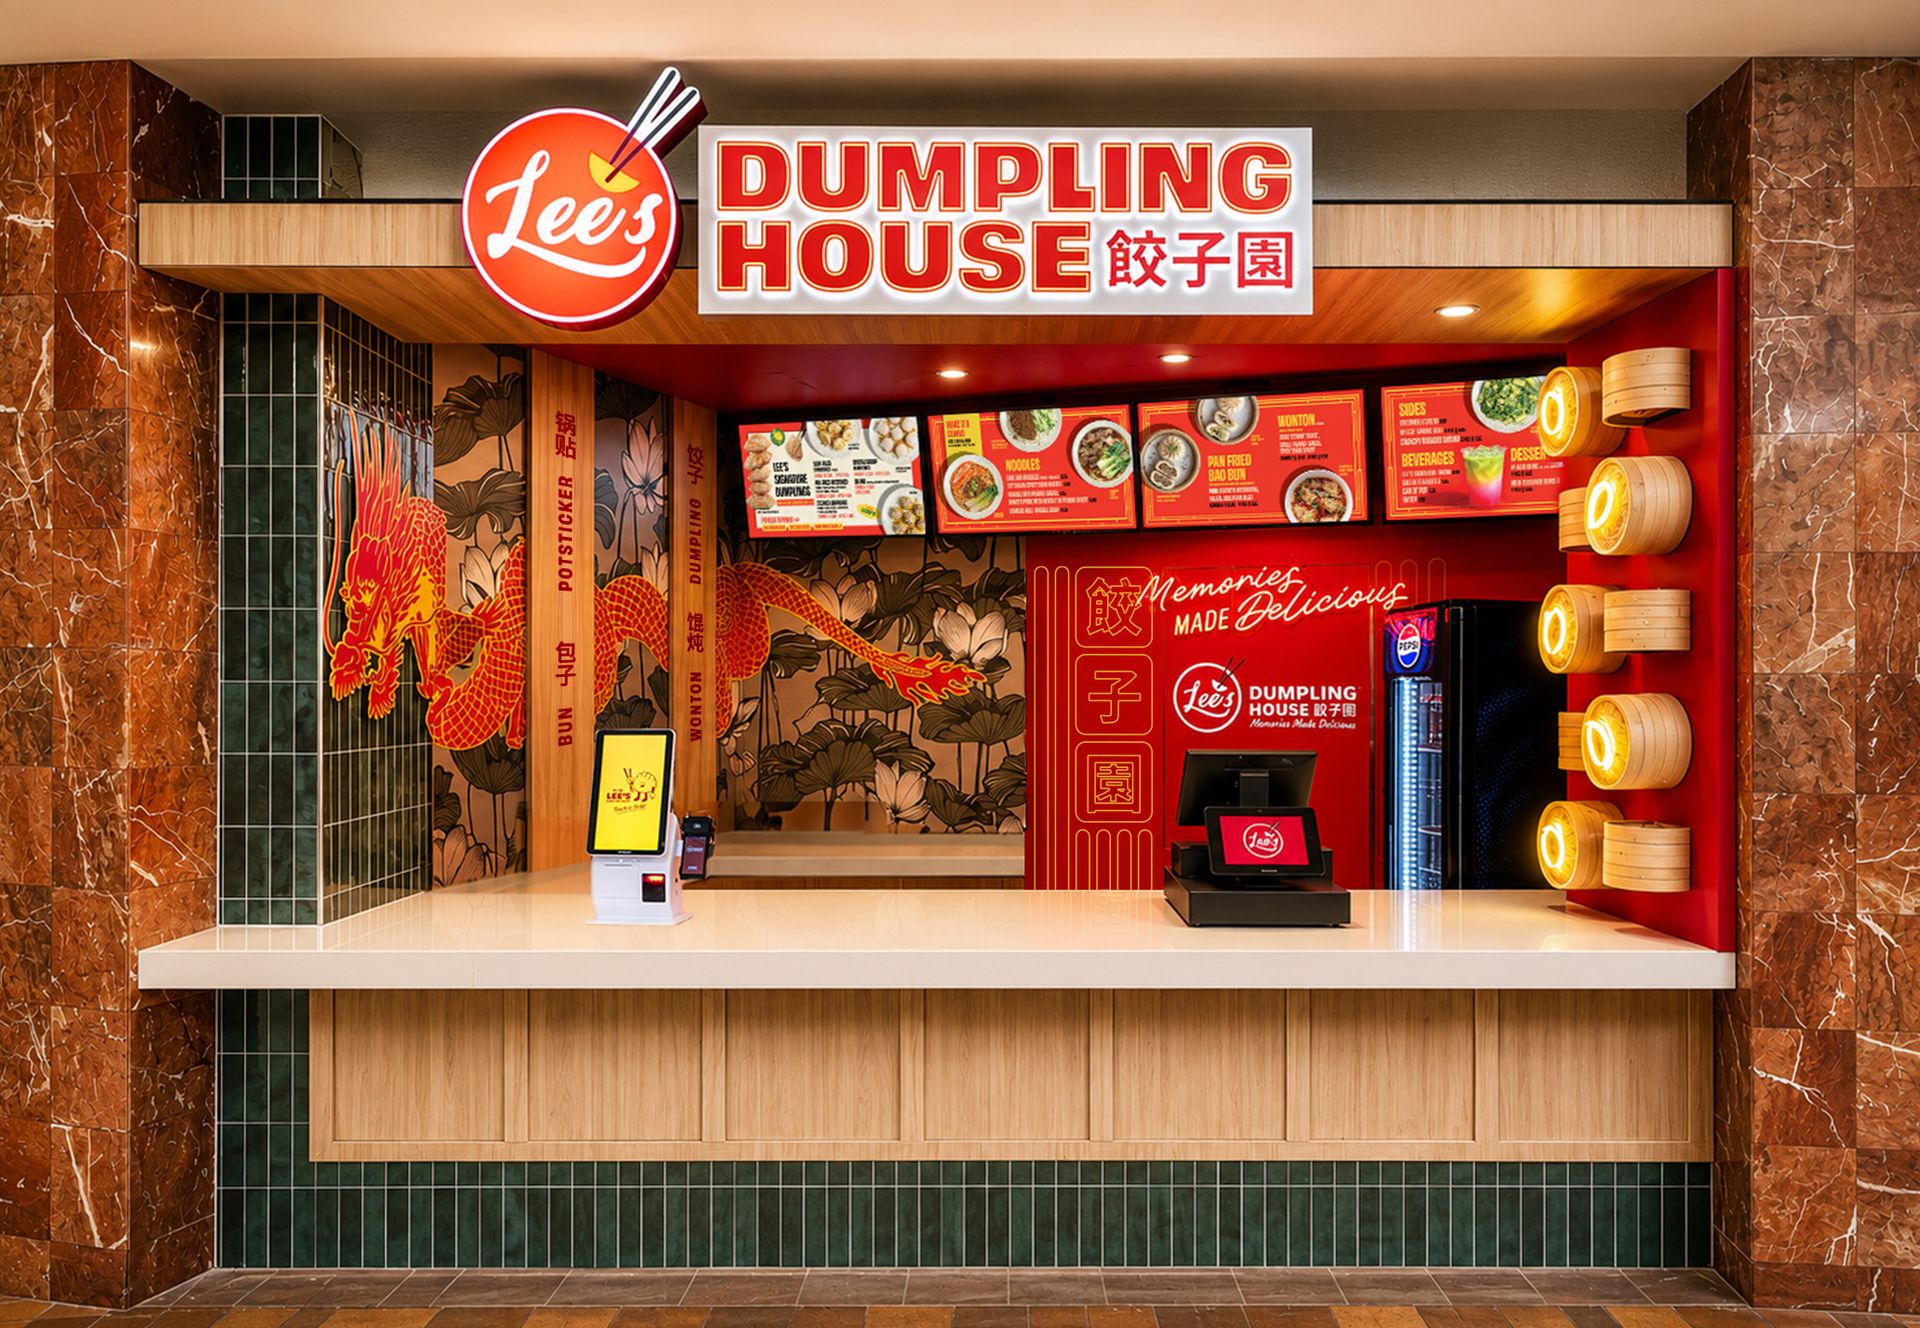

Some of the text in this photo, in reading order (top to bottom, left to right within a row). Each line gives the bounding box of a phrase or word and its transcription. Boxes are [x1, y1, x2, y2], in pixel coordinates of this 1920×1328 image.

[716, 140, 1293, 213] DUMPLING
[485, 149, 664, 280] Lee's
[716, 221, 1092, 293] HOUSE
[1105, 229, 1294, 290] 餃子園
[1277, 413, 1316, 427] WONTON
[1399, 402, 1426, 416] SIDES
[555, 411, 577, 460] 锅贴
[1511, 447, 1546, 462] DESSER
[687, 444, 704, 485] 饺子
[772, 462, 789, 473] LEE'S
[1005, 458, 1041, 472] NOODLES
[1207, 453, 1252, 468] PAN FRIED
[1208, 468, 1246, 482] BAO BUN
[1401, 451, 1455, 468] BEVERAGES
[774, 474, 809, 485] SIGNATURE
[775, 486, 812, 497] DUMPLINGS
[558, 475, 573, 592] POTSTICKER
[690, 498, 702, 585] DUMPLING
[1136, 566, 1303, 611] Memories
[1174, 582, 1408, 636] MADE Delicious
[555, 641, 577, 686] 包子
[1399, 640, 1420, 651] PEPSI
[690, 672, 702, 741] WONTON
[1183, 680, 1235, 718] Lee's
[1249, 686, 1357, 701] DUMPLING
[1249, 703, 1309, 717] HOUSE
[558, 707, 573, 746] BUN
